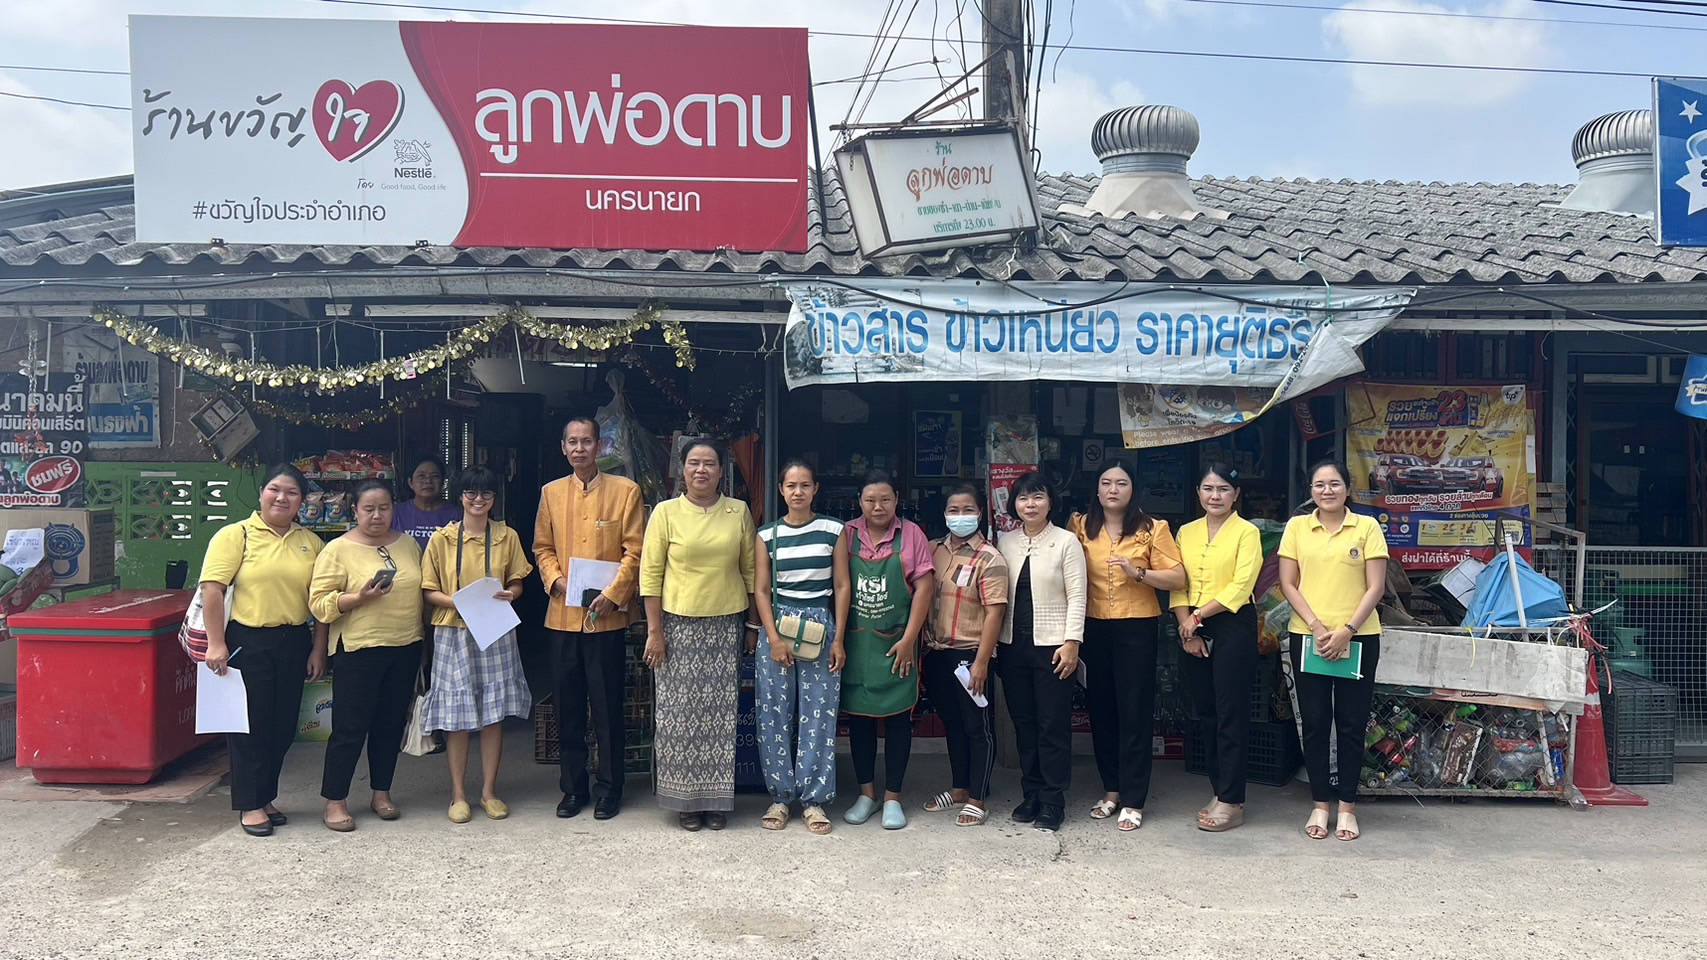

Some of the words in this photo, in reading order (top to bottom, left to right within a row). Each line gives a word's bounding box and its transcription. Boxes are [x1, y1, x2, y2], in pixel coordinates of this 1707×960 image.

[475, 73, 792, 164] ลูกพ่อดาบ
[935, 141, 953, 156] ร้าน
[418, 183, 435, 191] Good
[906, 157, 994, 202] ลูกพ่อดาบ
[585, 189, 701, 212] นครนายก
[193, 197, 386, 223] #ขวัญใจประจำอำเภอ
[964, 218, 987, 231] 23.00
[804, 299, 930, 356] ข้าวสาร
[0, 415, 85, 432] มินิคอนเสิร์ต
[1133, 430, 1158, 438] Please
[1134, 438, 1159, 447] before
[1162, 434, 1194, 445] entering
[60, 440, 84, 454] 90
[31, 459, 74, 488] ชมฟรี
